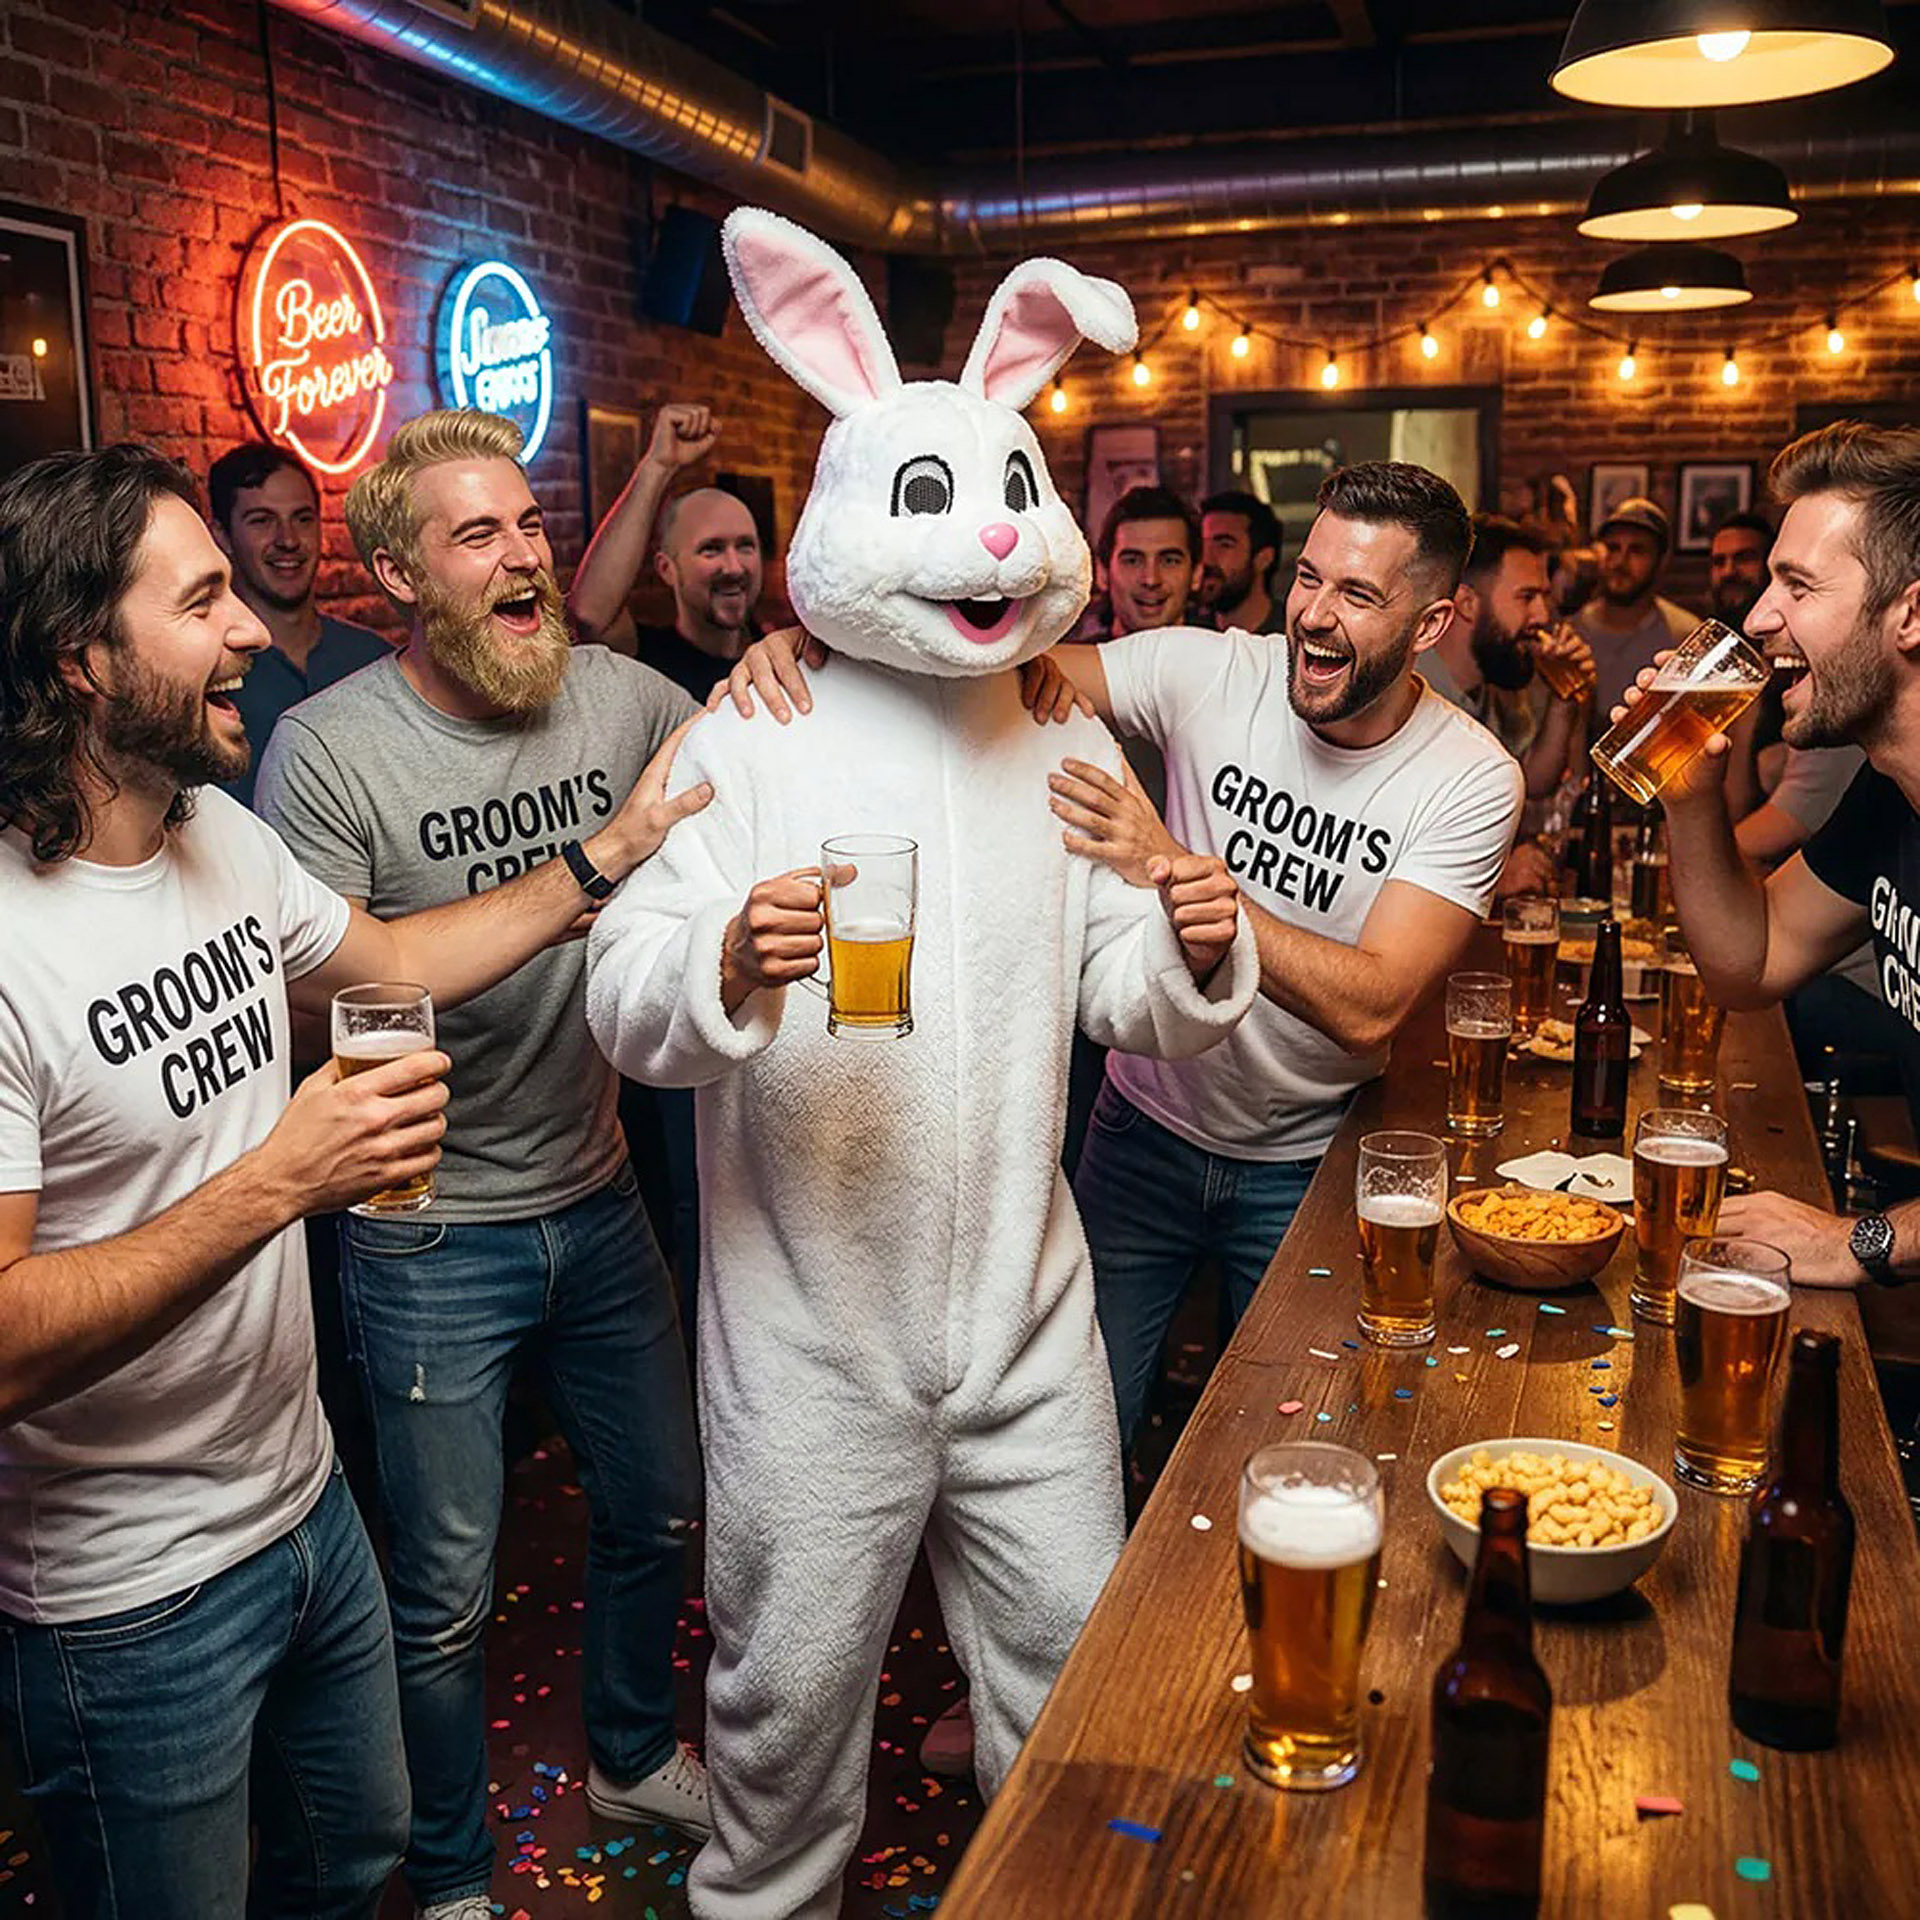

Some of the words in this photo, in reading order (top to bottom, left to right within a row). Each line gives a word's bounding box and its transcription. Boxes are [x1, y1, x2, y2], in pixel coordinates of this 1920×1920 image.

[276, 279, 361, 349] Beer
[262, 346, 393, 434] Forever
[419, 769, 613, 861] GROOM'S
[1212, 765, 1391, 874] GROOM'S
[467, 842, 562, 896] CR
[1225, 830, 1344, 913] CREW
[87, 915, 274, 1065] GROOM'S
[161, 998, 274, 1118] CREW
